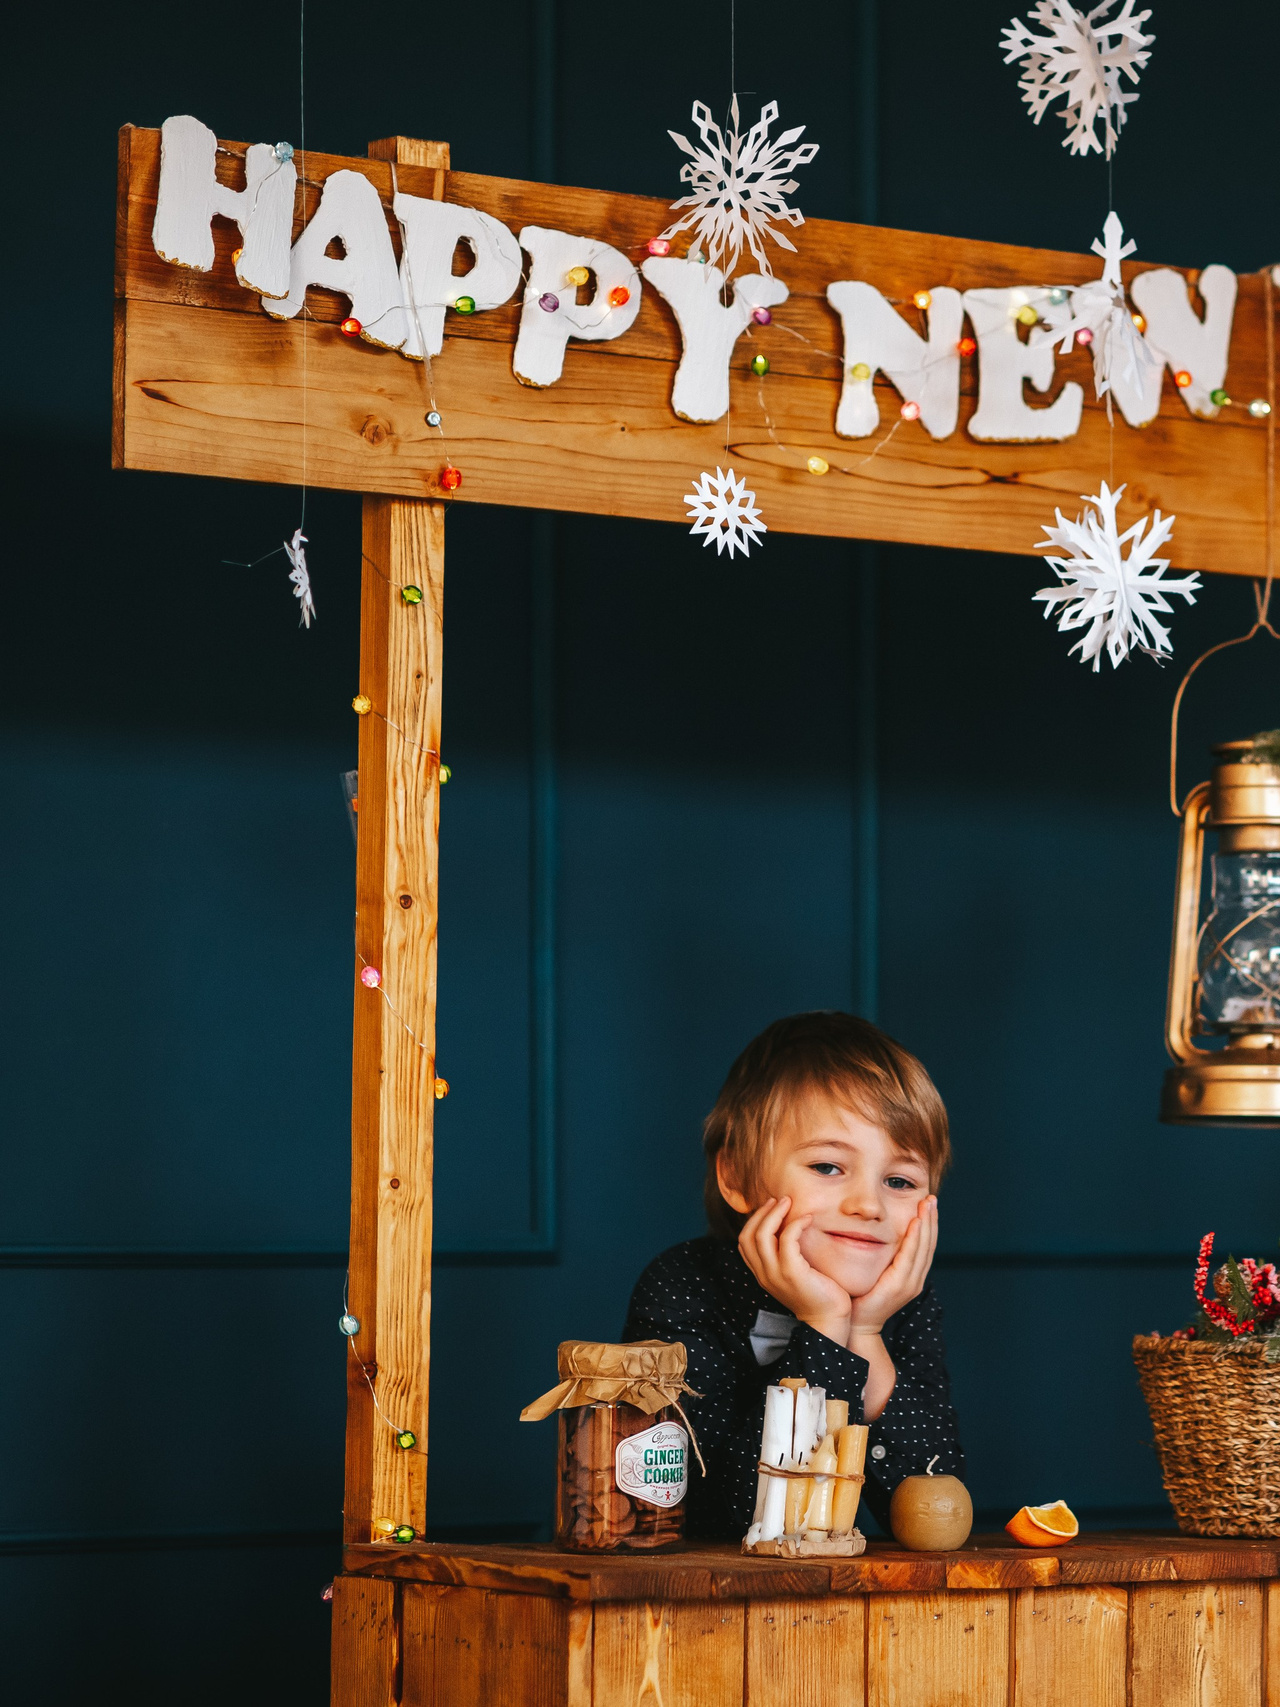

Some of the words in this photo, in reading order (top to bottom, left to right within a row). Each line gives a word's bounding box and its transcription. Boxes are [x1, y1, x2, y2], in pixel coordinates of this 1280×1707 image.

[152, 115, 789, 424] HAPPY
[827, 264, 1238, 443] NEW
[643, 1448, 684, 1465] GINGER
[643, 1467, 684, 1484] COOKIE
